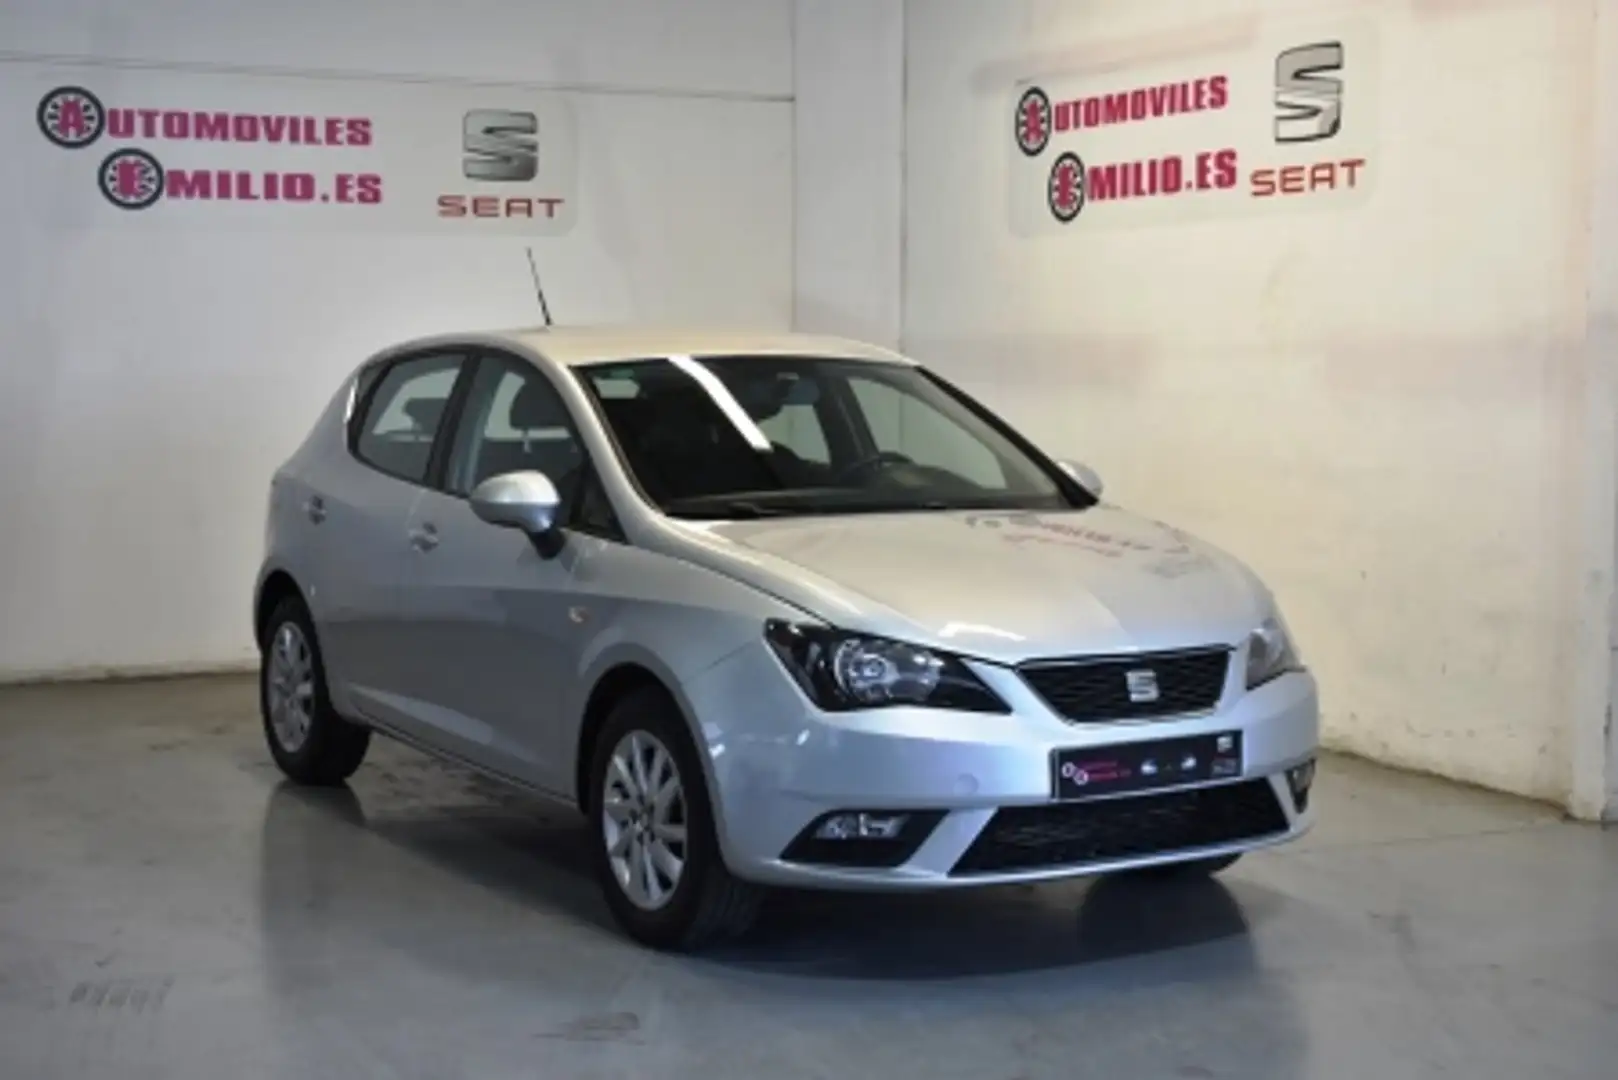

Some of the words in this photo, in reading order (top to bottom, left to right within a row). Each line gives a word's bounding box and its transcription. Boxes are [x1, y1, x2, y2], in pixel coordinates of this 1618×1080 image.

[57, 98, 372, 146] AUTOMOVILES
[1021, 75, 1229, 143] AUTOMOVILES
[115, 159, 383, 204] EMILIO.ES
[1250, 159, 1365, 197] SEAT
[437, 195, 565, 218] SEAT
